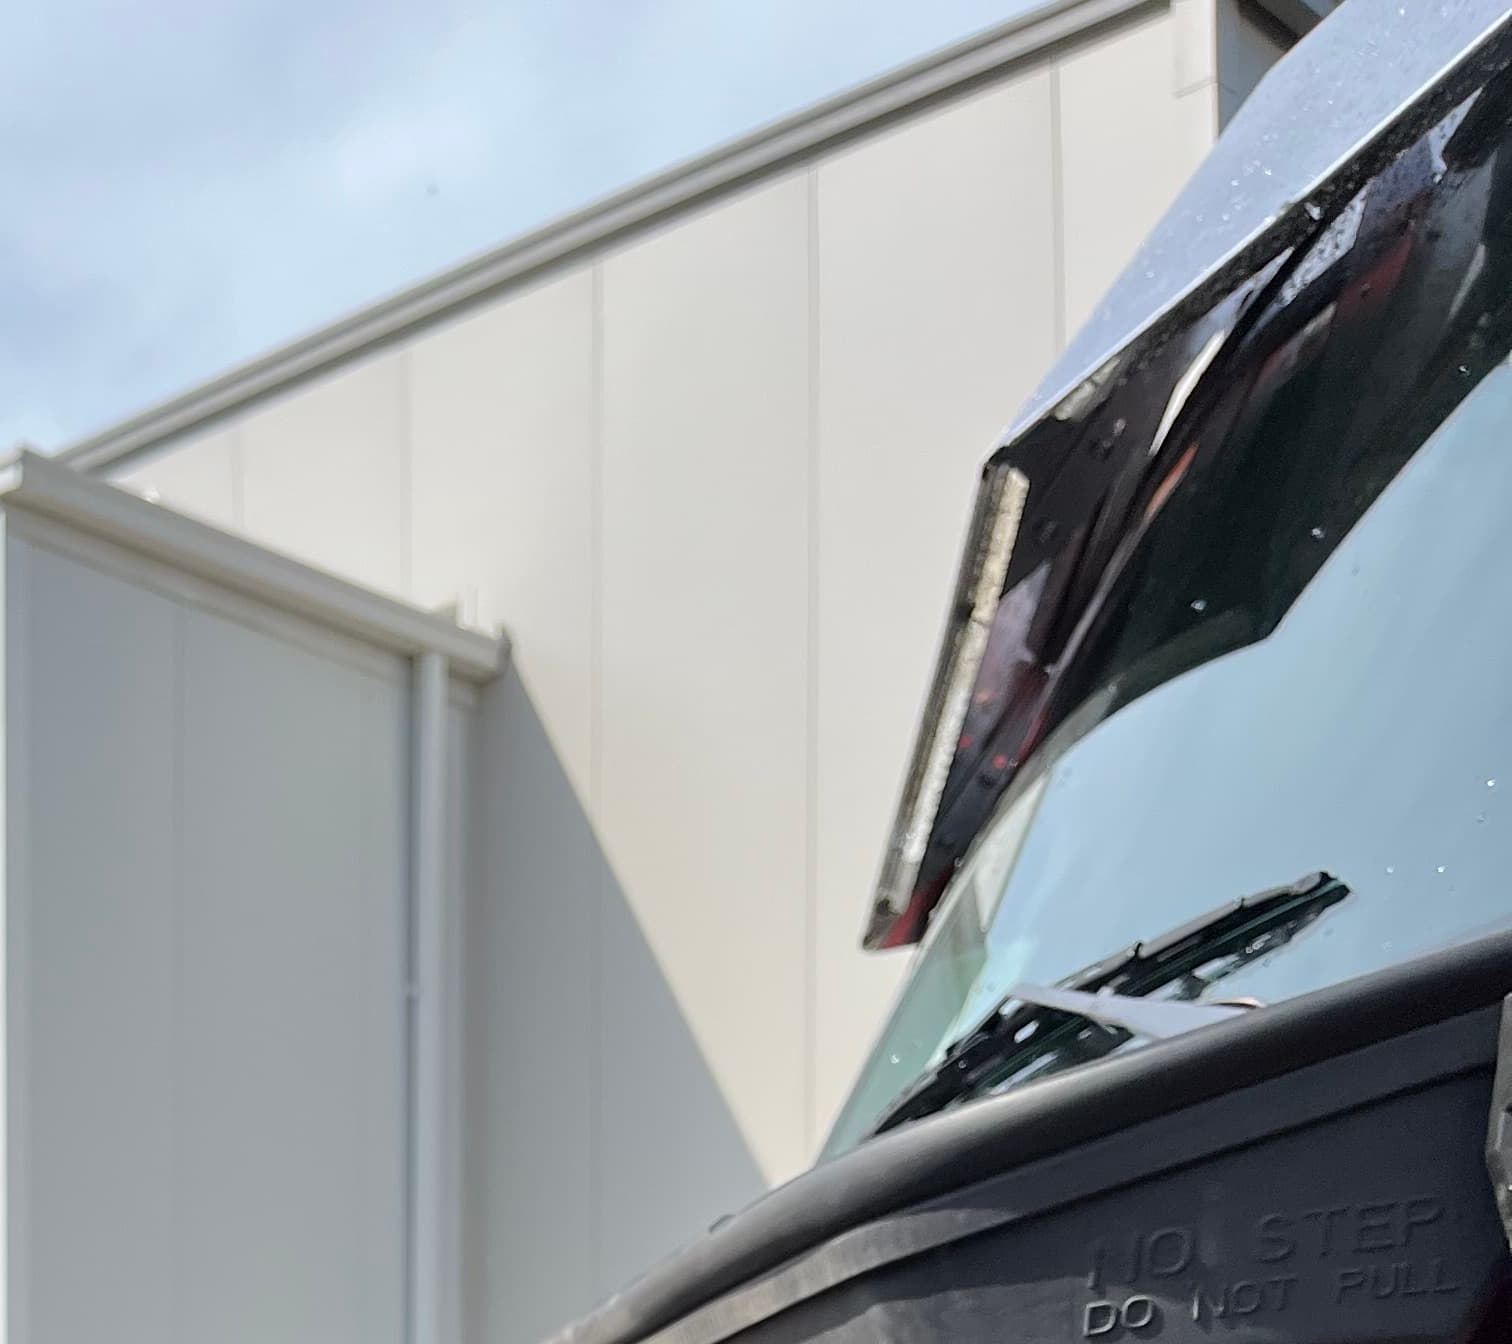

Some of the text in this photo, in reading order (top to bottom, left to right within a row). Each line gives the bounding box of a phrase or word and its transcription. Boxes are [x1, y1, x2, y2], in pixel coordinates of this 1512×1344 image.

[1254, 1200, 1446, 1266] STEP
[1083, 1260, 1462, 1337] DO NOT PULL
